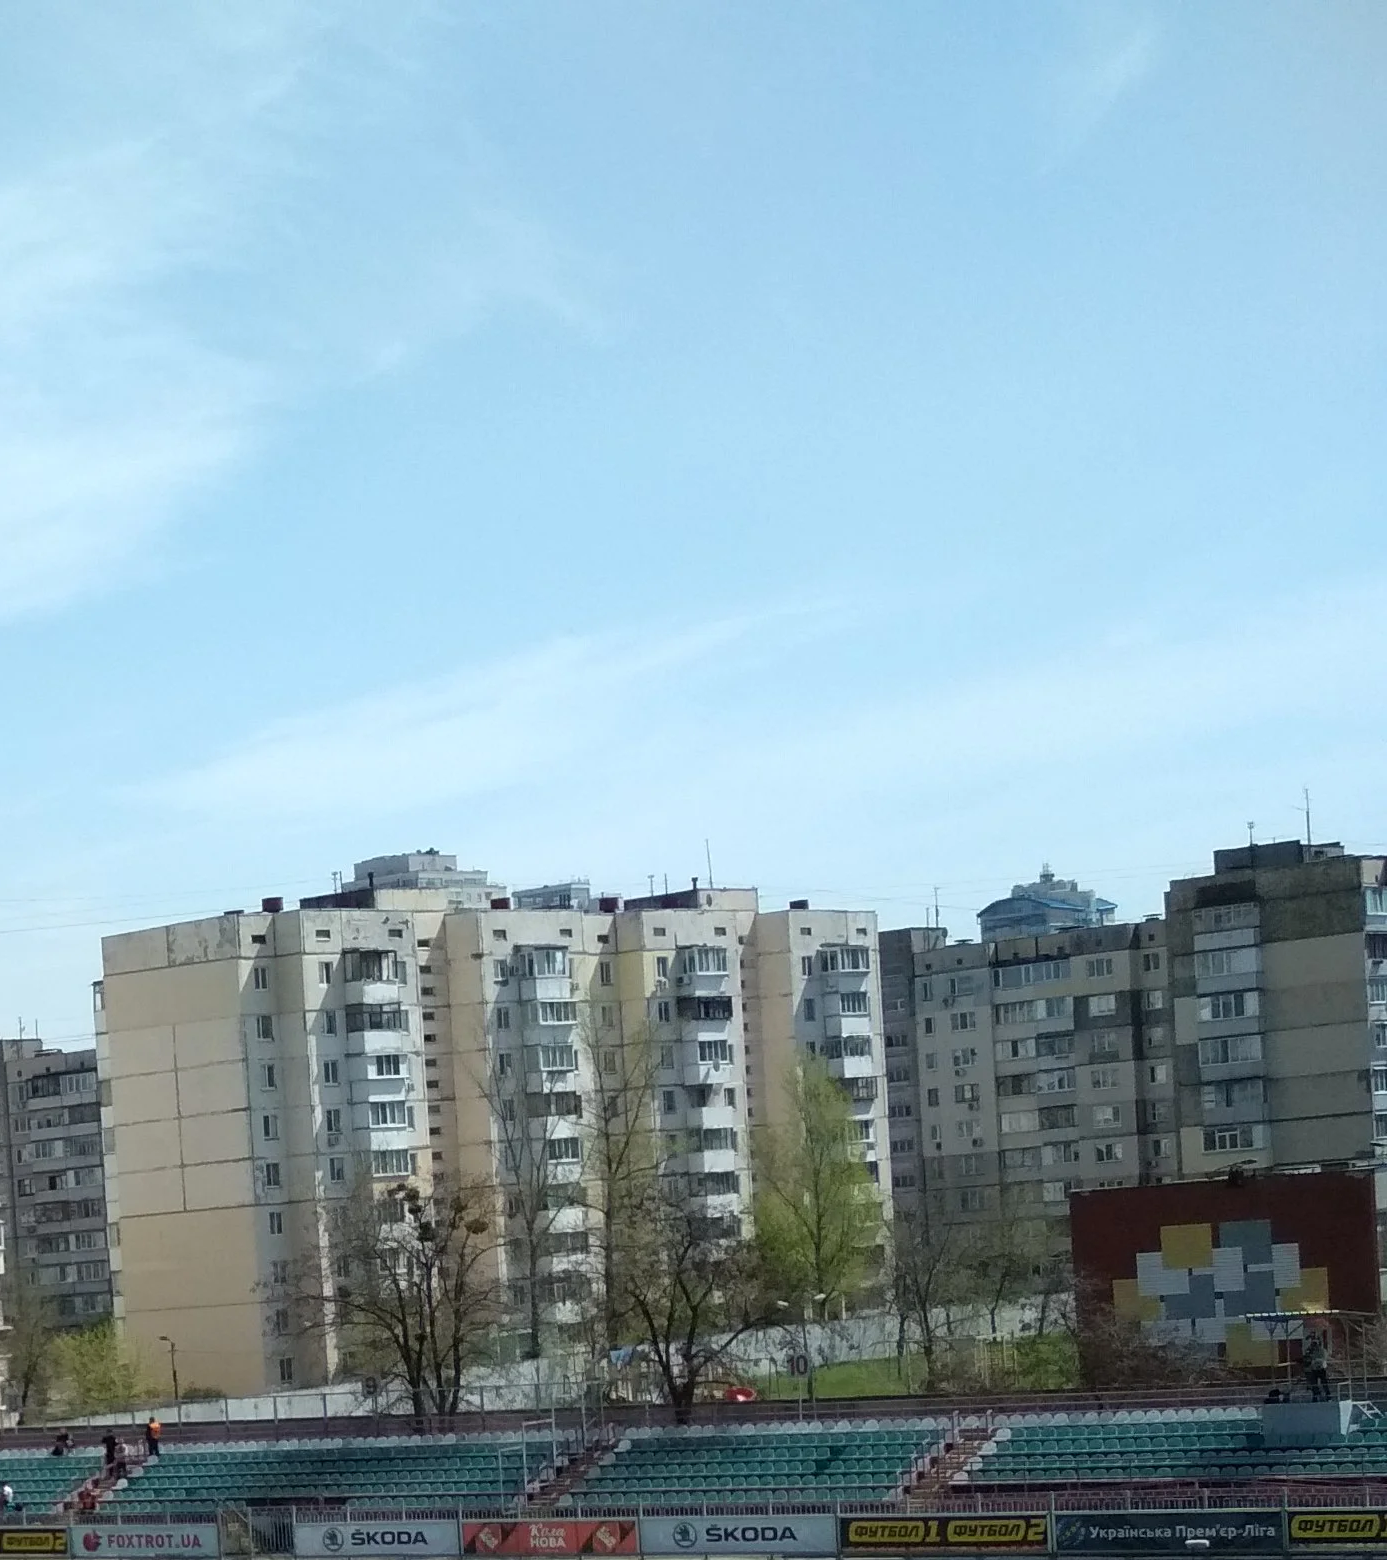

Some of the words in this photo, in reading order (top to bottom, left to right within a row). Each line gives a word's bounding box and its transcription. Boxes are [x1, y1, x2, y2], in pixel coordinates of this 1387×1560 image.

[786, 1353, 808, 1376] 10
[527, 1523, 567, 1538] Кола
[704, 1524, 798, 1543] ŠKODA
[852, 1524, 921, 1539] ФУТБОЛ
[925, 1521, 941, 1542] 1
[952, 1523, 1022, 1538] ФУТБОЛ
[1027, 1519, 1047, 1541] 2
[1089, 1523, 1172, 1540] Українська
[1175, 1523, 1275, 1540] Прем'єр-Ліга
[1297, 1518, 1374, 1534] ФУТБОЛ
[107, 1533, 202, 1549] FOXTROT.UA
[350, 1529, 429, 1546] ŠKODA
[529, 1536, 567, 1549] НОВА
